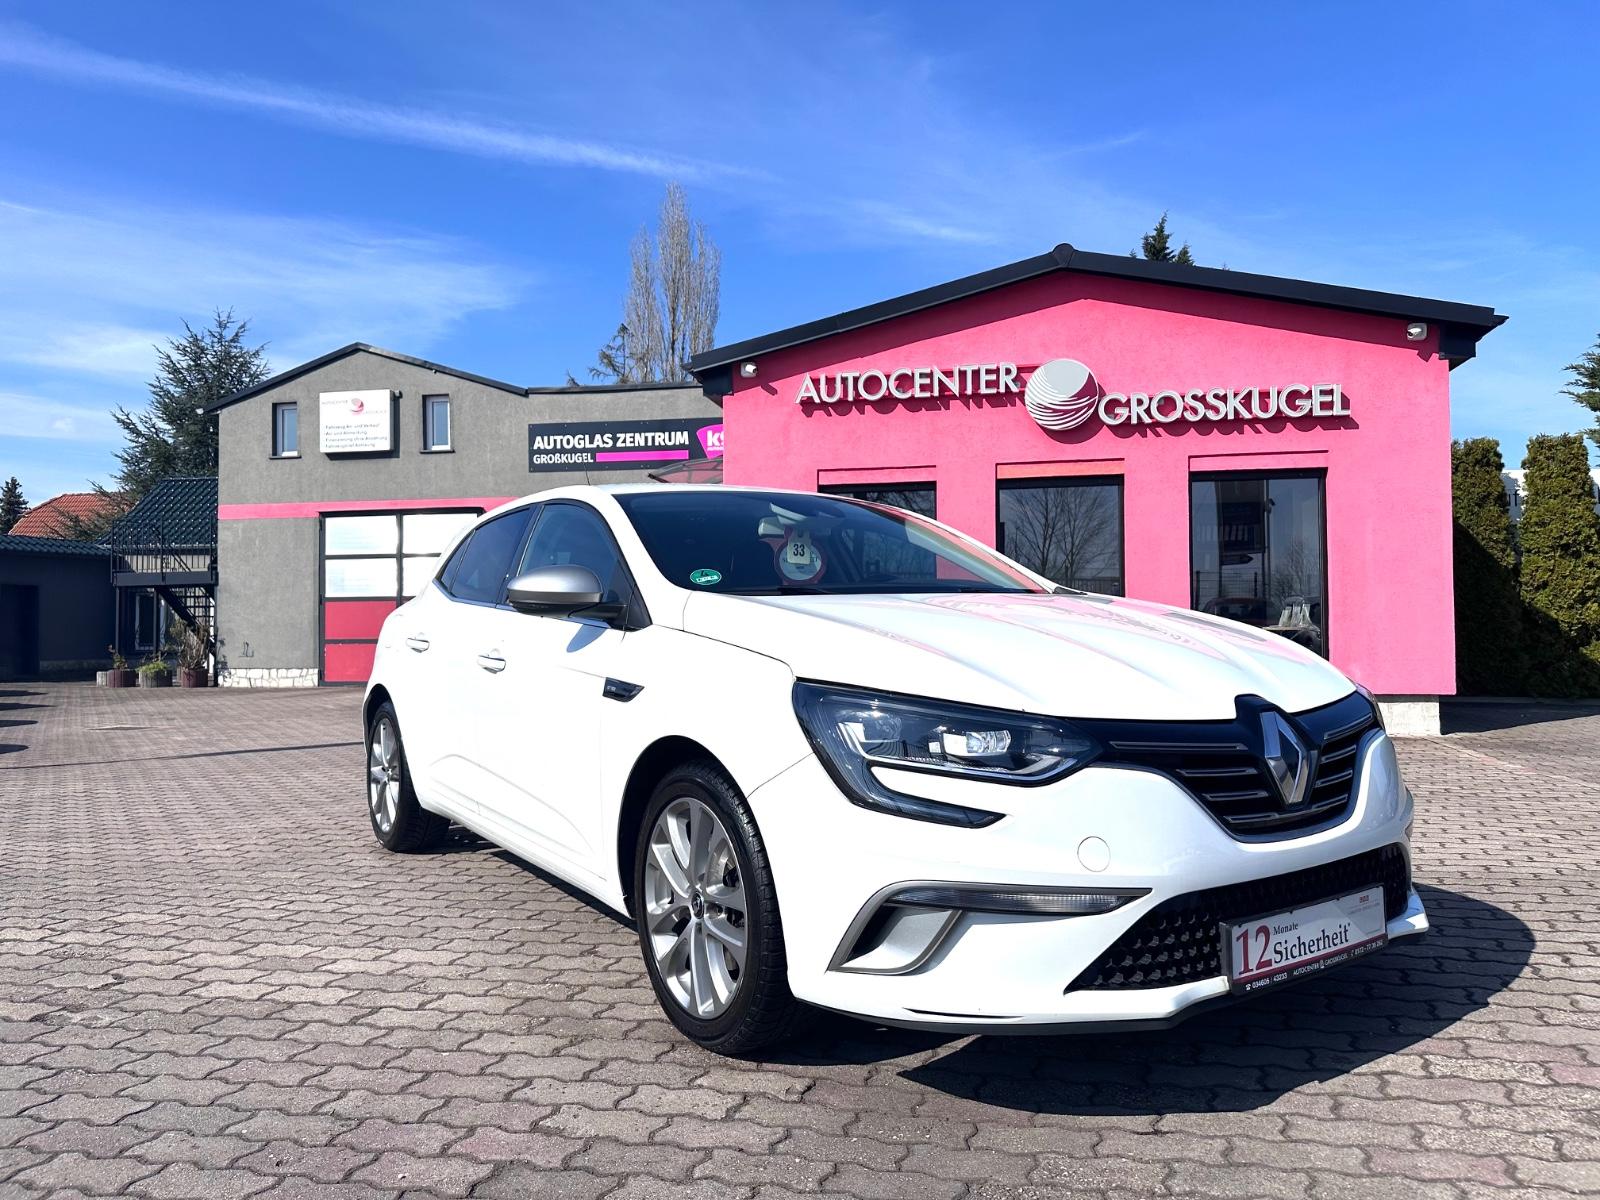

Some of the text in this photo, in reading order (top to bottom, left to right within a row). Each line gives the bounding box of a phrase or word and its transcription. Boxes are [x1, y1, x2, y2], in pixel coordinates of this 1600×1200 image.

[796, 362, 1351, 426] AUTOCENTER GROSSKUGEL
[533, 430, 689, 450] AUTOGLAS ZENTRUM
[533, 452, 594, 464] GROßKUGEL
[793, 543, 805, 557] 33
[1273, 922, 1299, 936] Monate
[1236, 924, 1272, 975] 12
